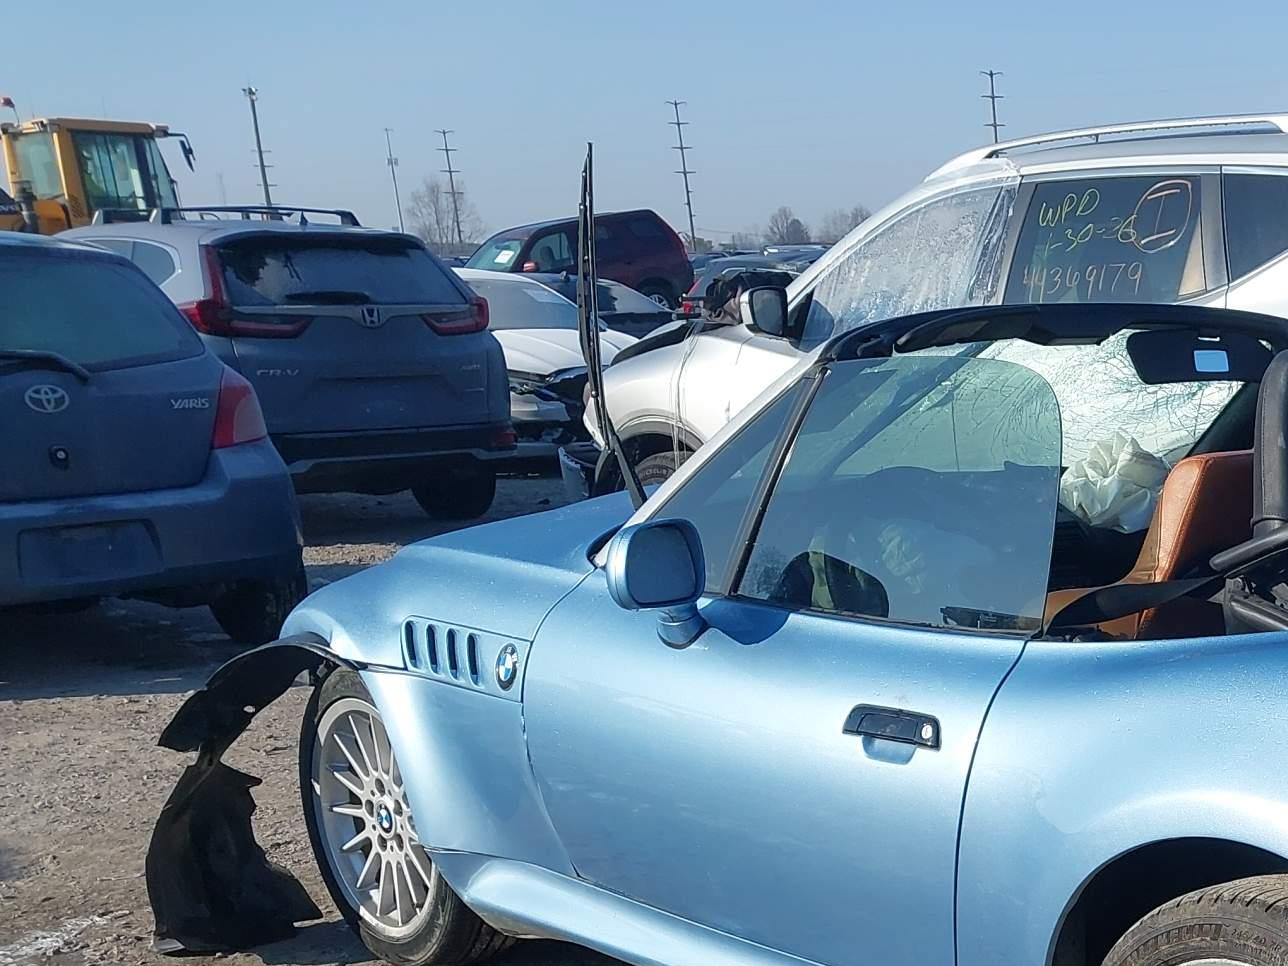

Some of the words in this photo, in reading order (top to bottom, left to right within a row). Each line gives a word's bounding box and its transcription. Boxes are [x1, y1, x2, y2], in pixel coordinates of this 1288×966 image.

[1039, 188, 1100, 227] WPD
[1023, 261, 1143, 304] 44369179
[256, 369, 299, 377] CR-V
[170, 397, 209, 409] YARIS
